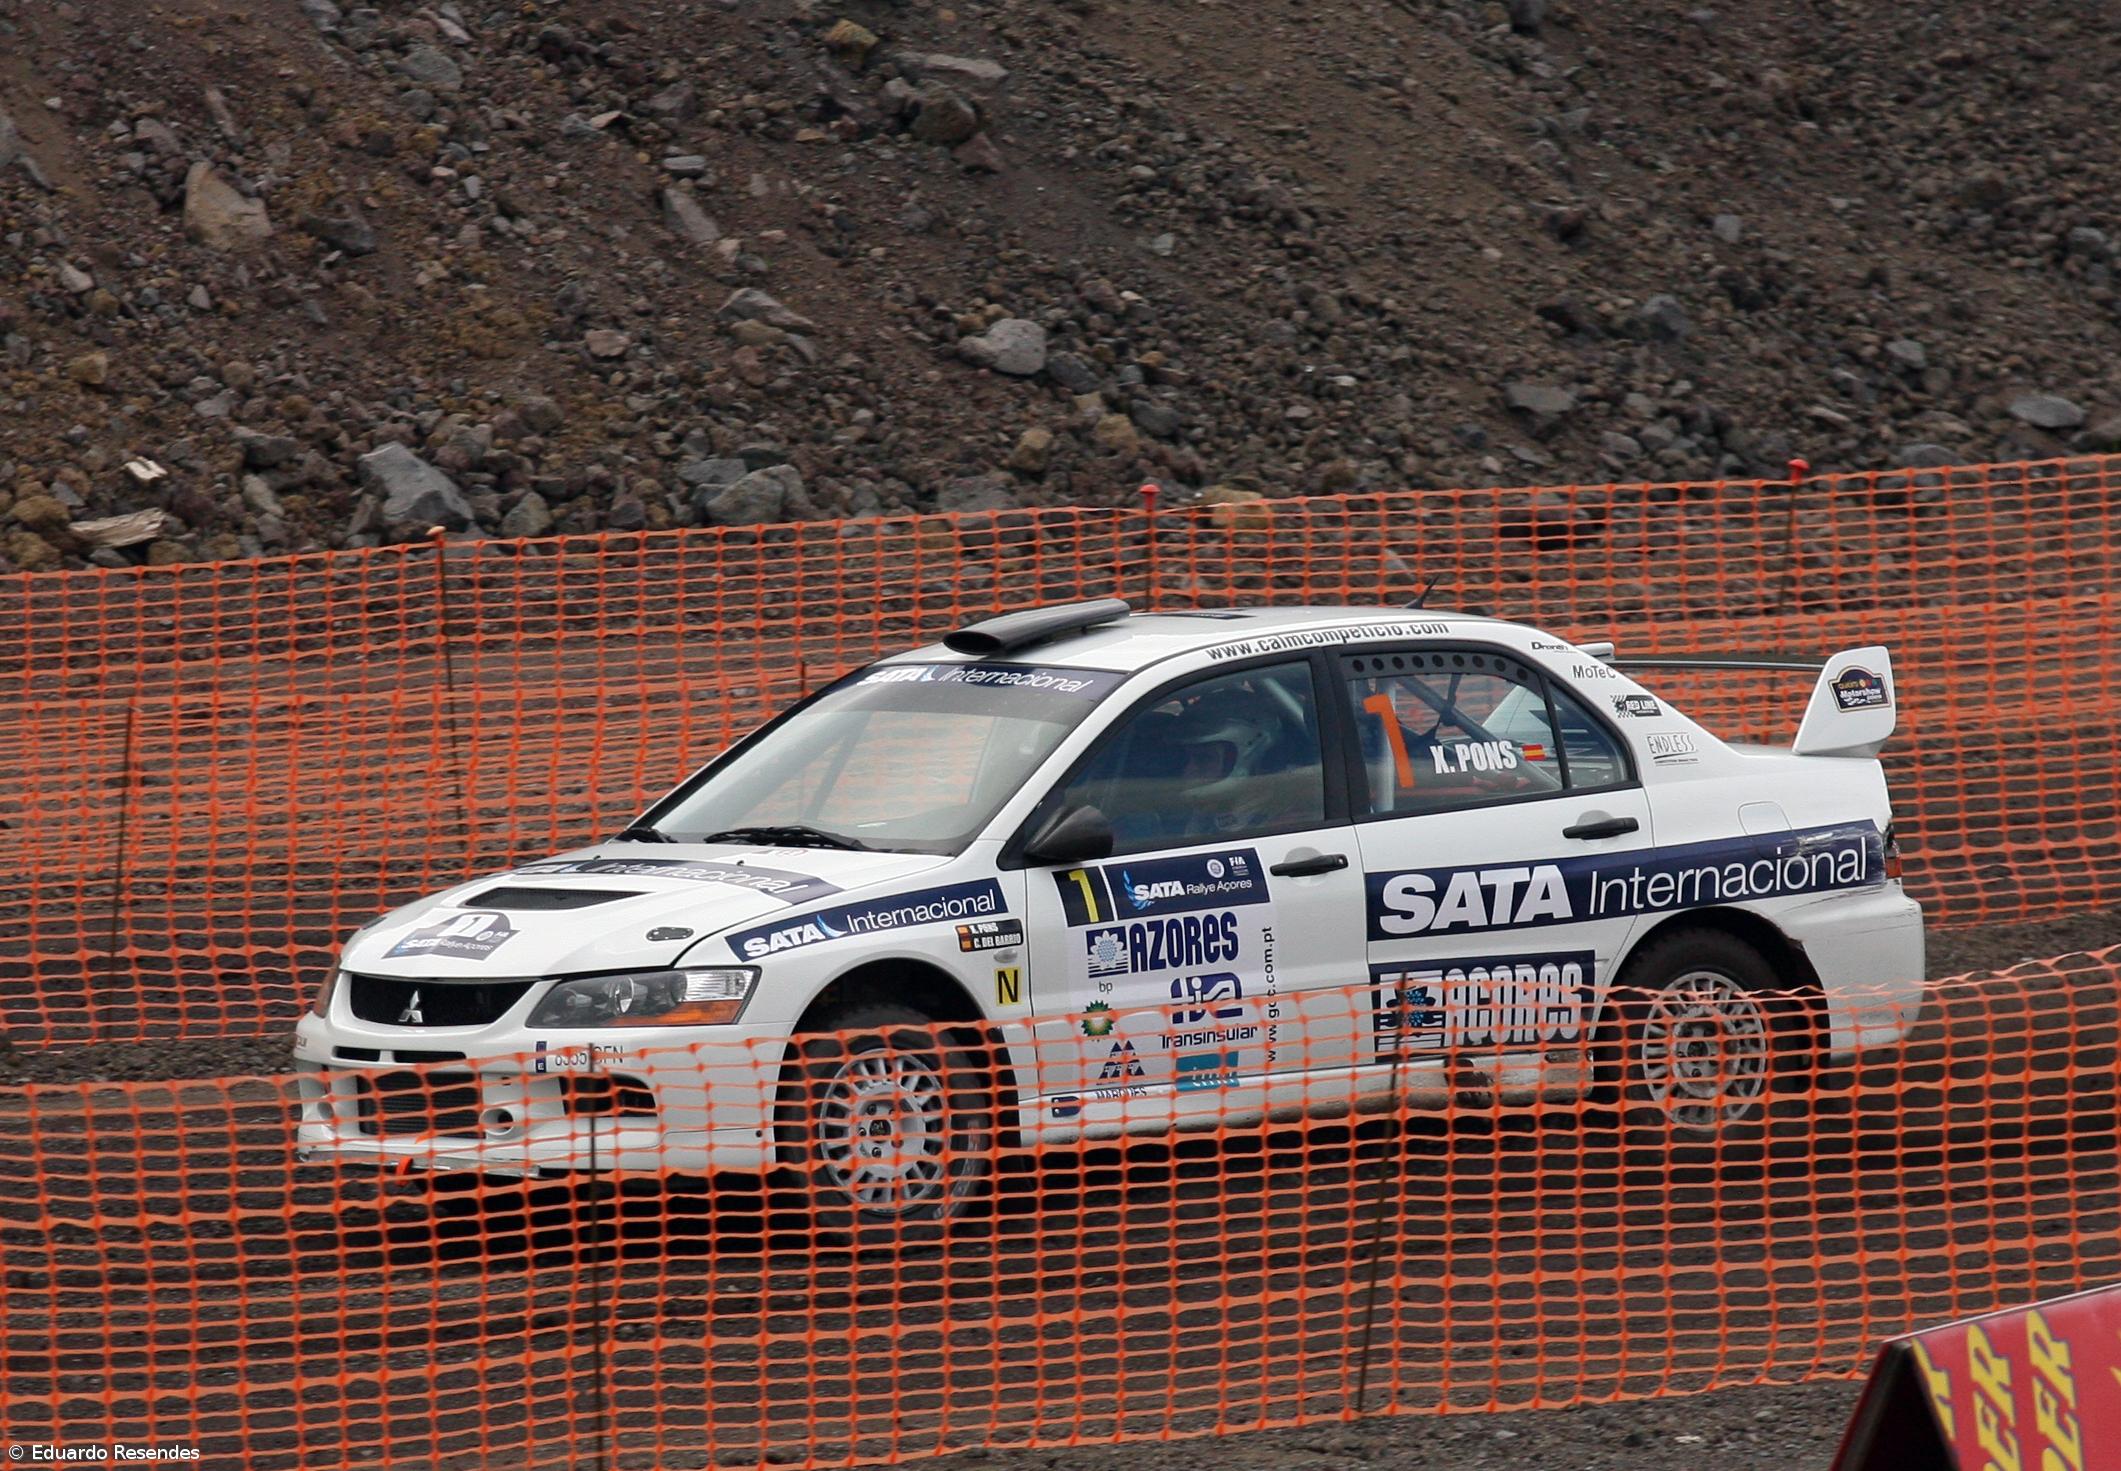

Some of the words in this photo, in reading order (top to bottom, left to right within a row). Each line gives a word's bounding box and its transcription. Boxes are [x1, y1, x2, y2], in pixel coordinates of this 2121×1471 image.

[857, 667, 925, 686] SATA
[938, 668, 1094, 693] Internacional
[1362, 693, 1415, 788] 1
[1429, 744, 1455, 774] X.
[1455, 740, 1518, 773] PONS
[1647, 734, 1696, 754] ENDLESS
[1069, 867, 1099, 923] 1
[1133, 880, 1186, 900] SATA
[1186, 882, 1215, 895] Rallye
[1217, 878, 1253, 892] Açores
[1379, 864, 1573, 934] SATA
[1589, 837, 1867, 914] Internacional
[743, 922, 825, 957] SATA
[846, 888, 996, 933] Internacional
[997, 969, 1018, 1004] N
[1098, 981, 1113, 993] bp
